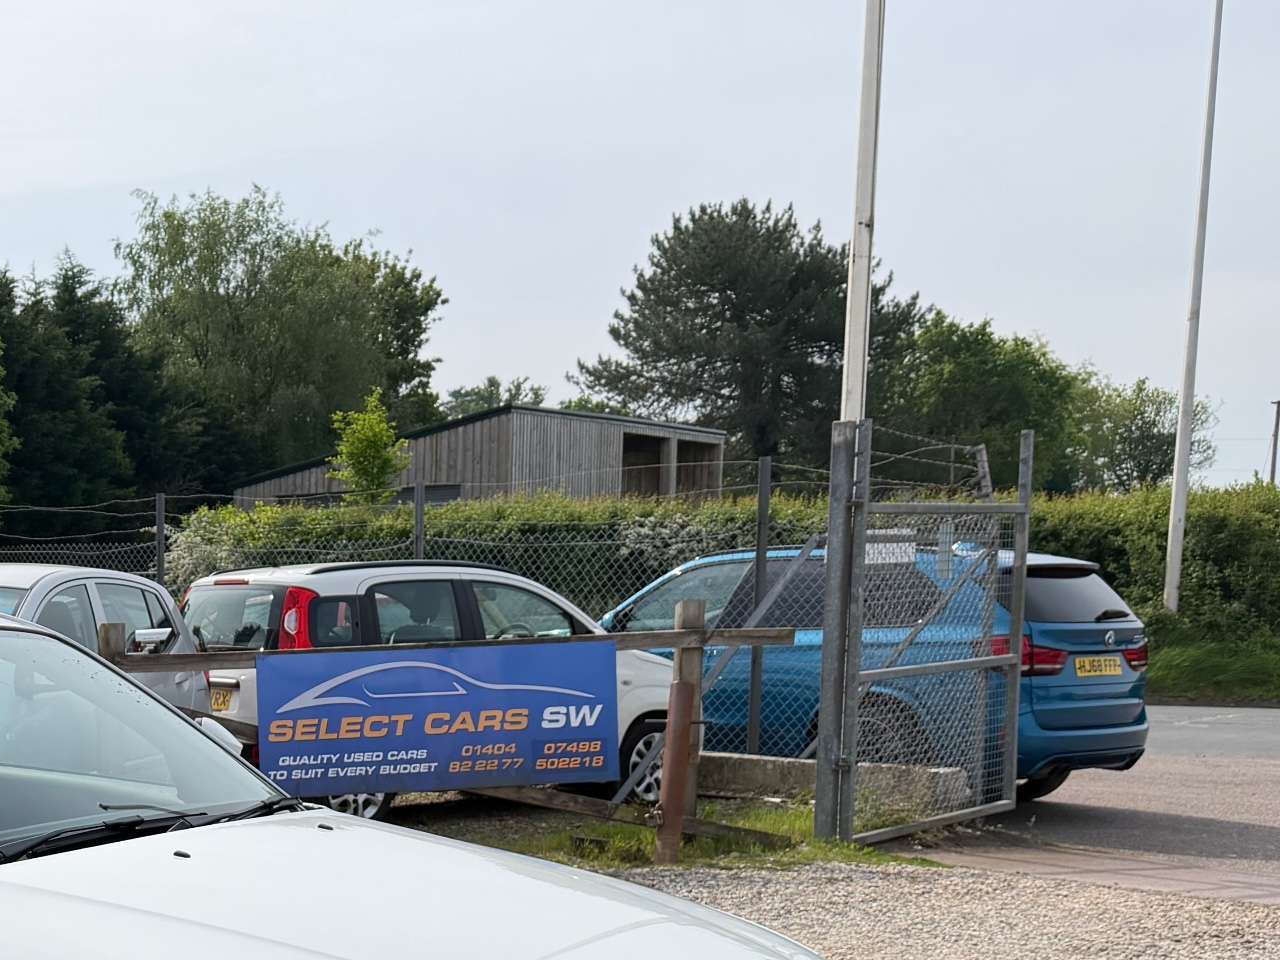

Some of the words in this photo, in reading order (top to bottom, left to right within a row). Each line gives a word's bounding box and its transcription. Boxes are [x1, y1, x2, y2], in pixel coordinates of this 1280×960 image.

[268, 714, 414, 743] SELECT
[424, 708, 529, 735] CARS
[541, 704, 603, 729] SW
[461, 743, 517, 757] 01404
[543, 740, 602, 755] 07498
[278, 753, 340, 767] QUALITY
[343, 751, 383, 763] USED
[387, 749, 428, 761] CARS
[535, 756, 604, 770] 502218
[268, 770, 288, 781] TO
[291, 768, 325, 780] SUIT
[327, 766, 376, 778] EVERY
[379, 762, 439, 775] BUDGET
